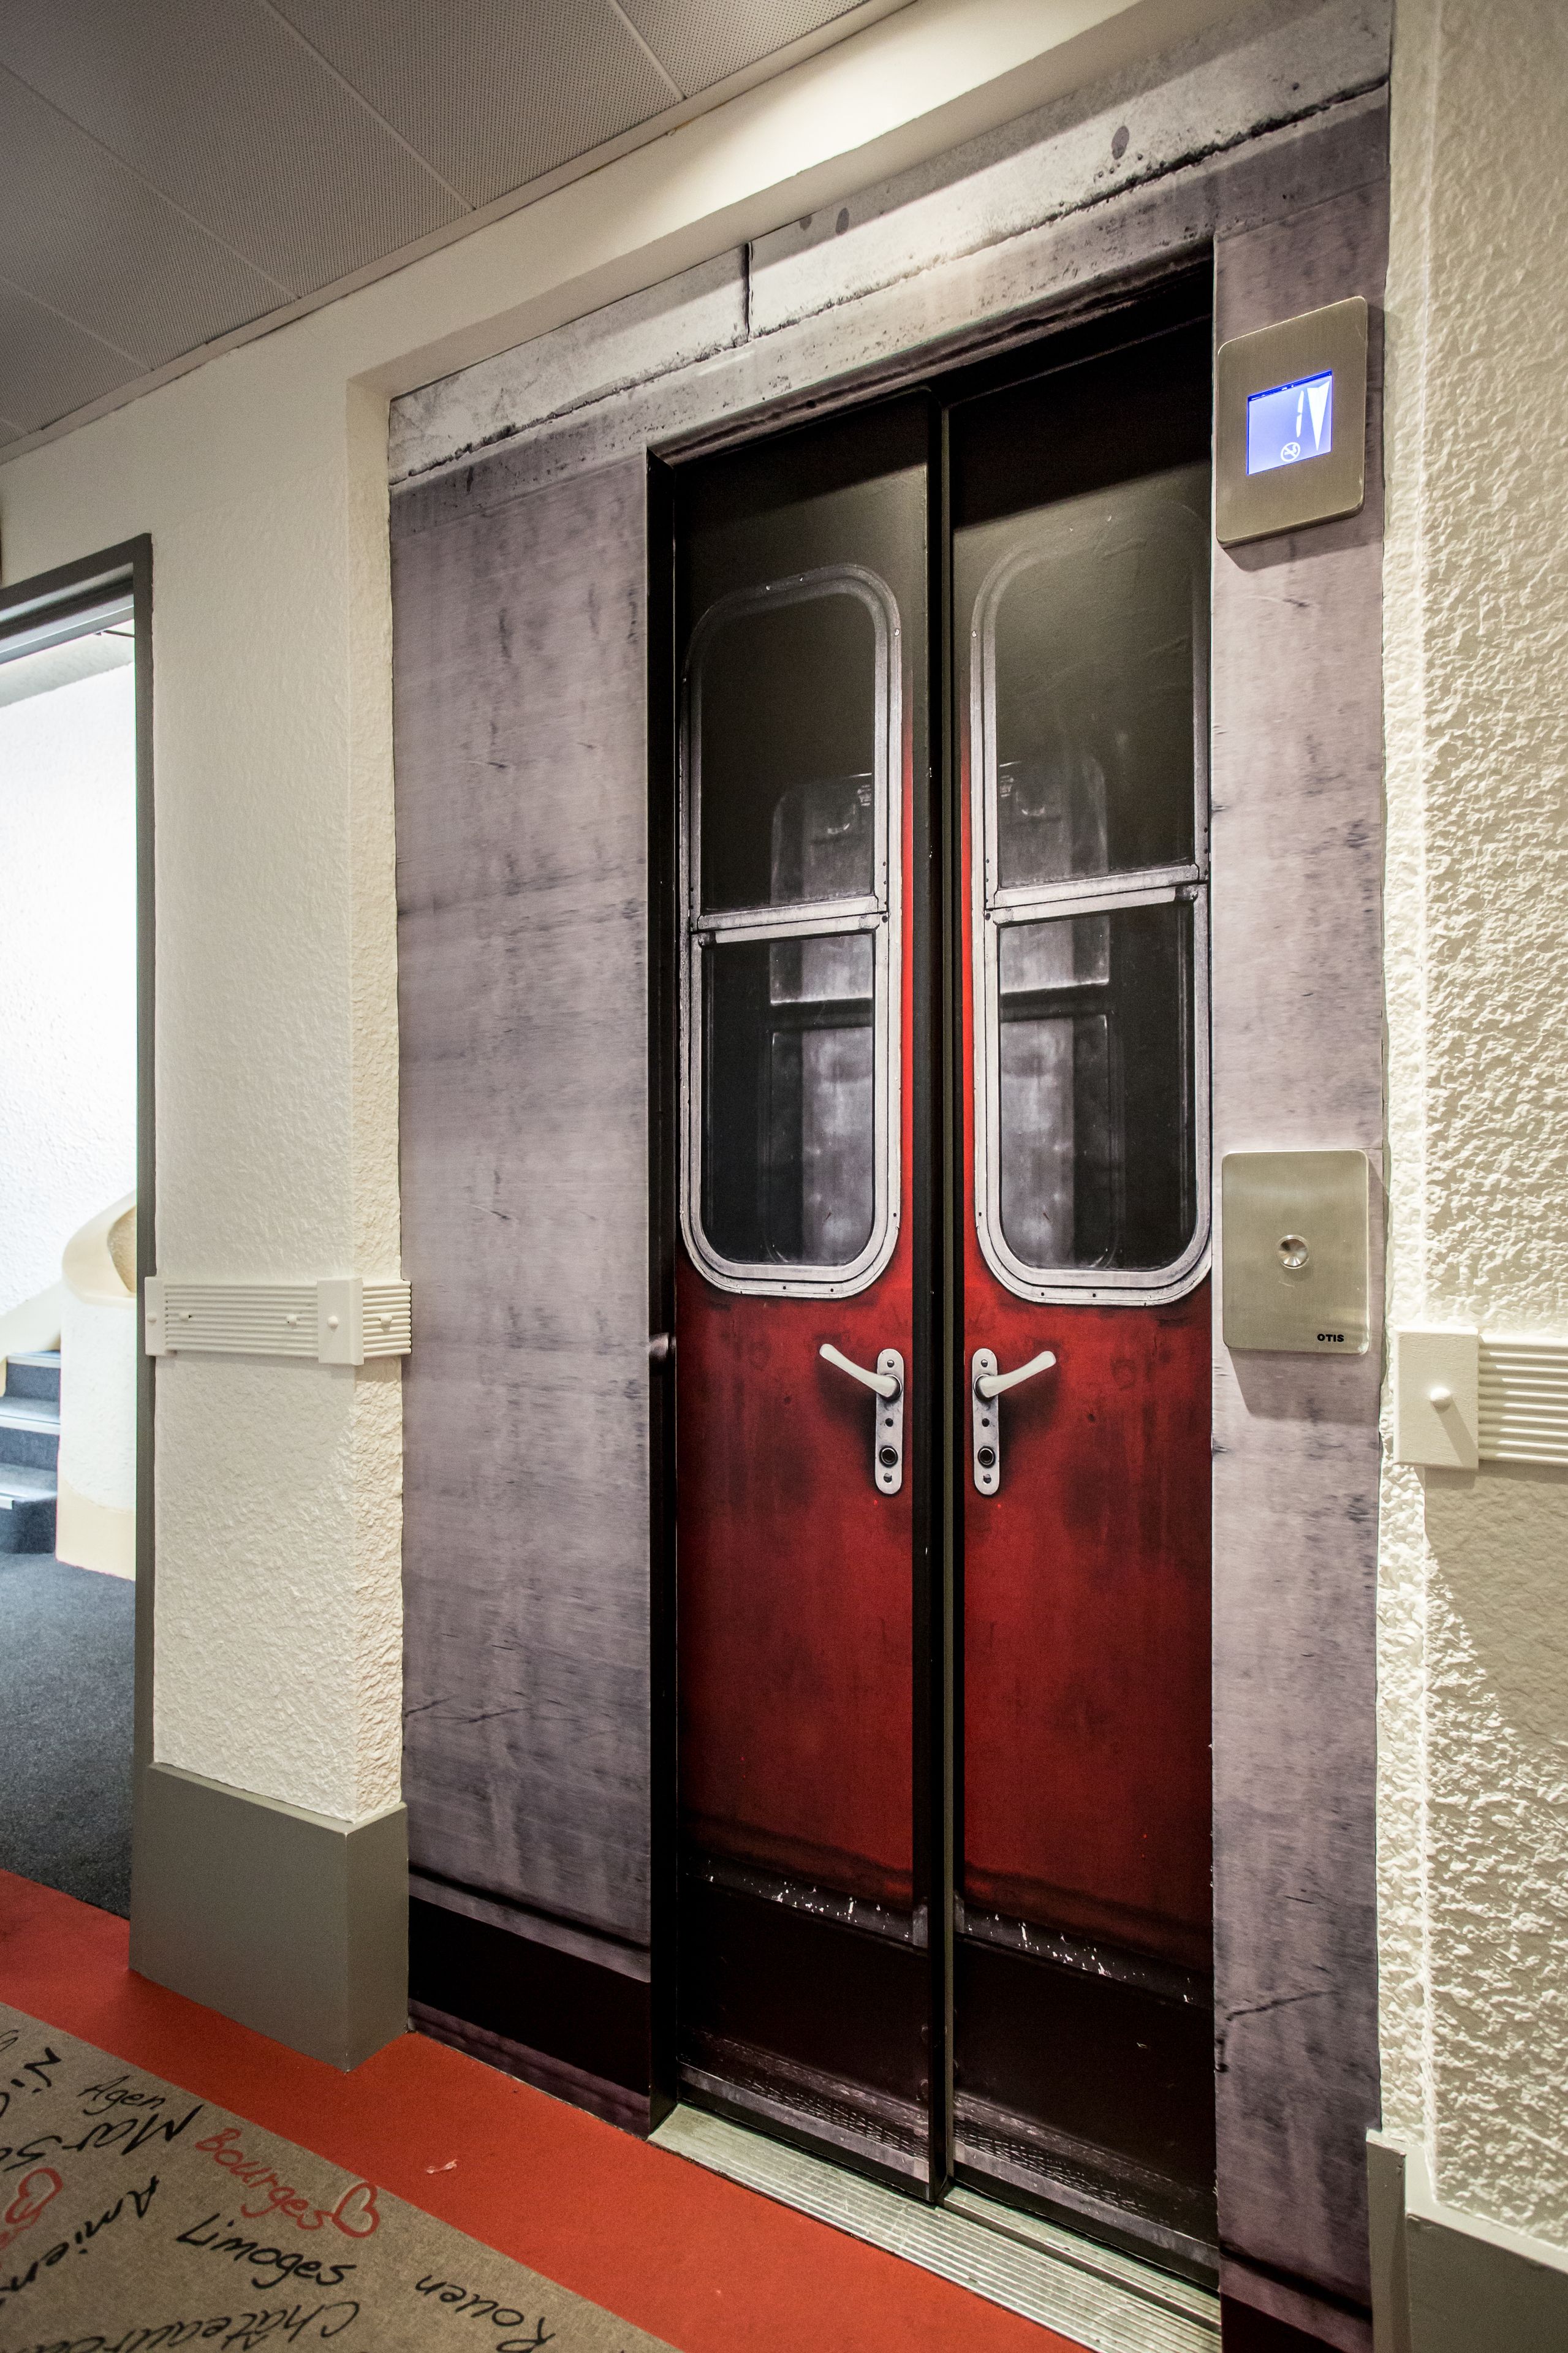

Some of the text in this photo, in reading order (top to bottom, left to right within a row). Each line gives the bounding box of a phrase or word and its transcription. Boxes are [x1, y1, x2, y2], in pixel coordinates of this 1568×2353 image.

[1317, 1333, 1344, 1342] OTIS
[77, 2075, 167, 2116] Agen
[195, 2128, 326, 2230] Bourges
[0, 2175, 160, 2305] Amien
[176, 2213, 357, 2289] Limoges
[415, 2274, 556, 2353] Rouen
